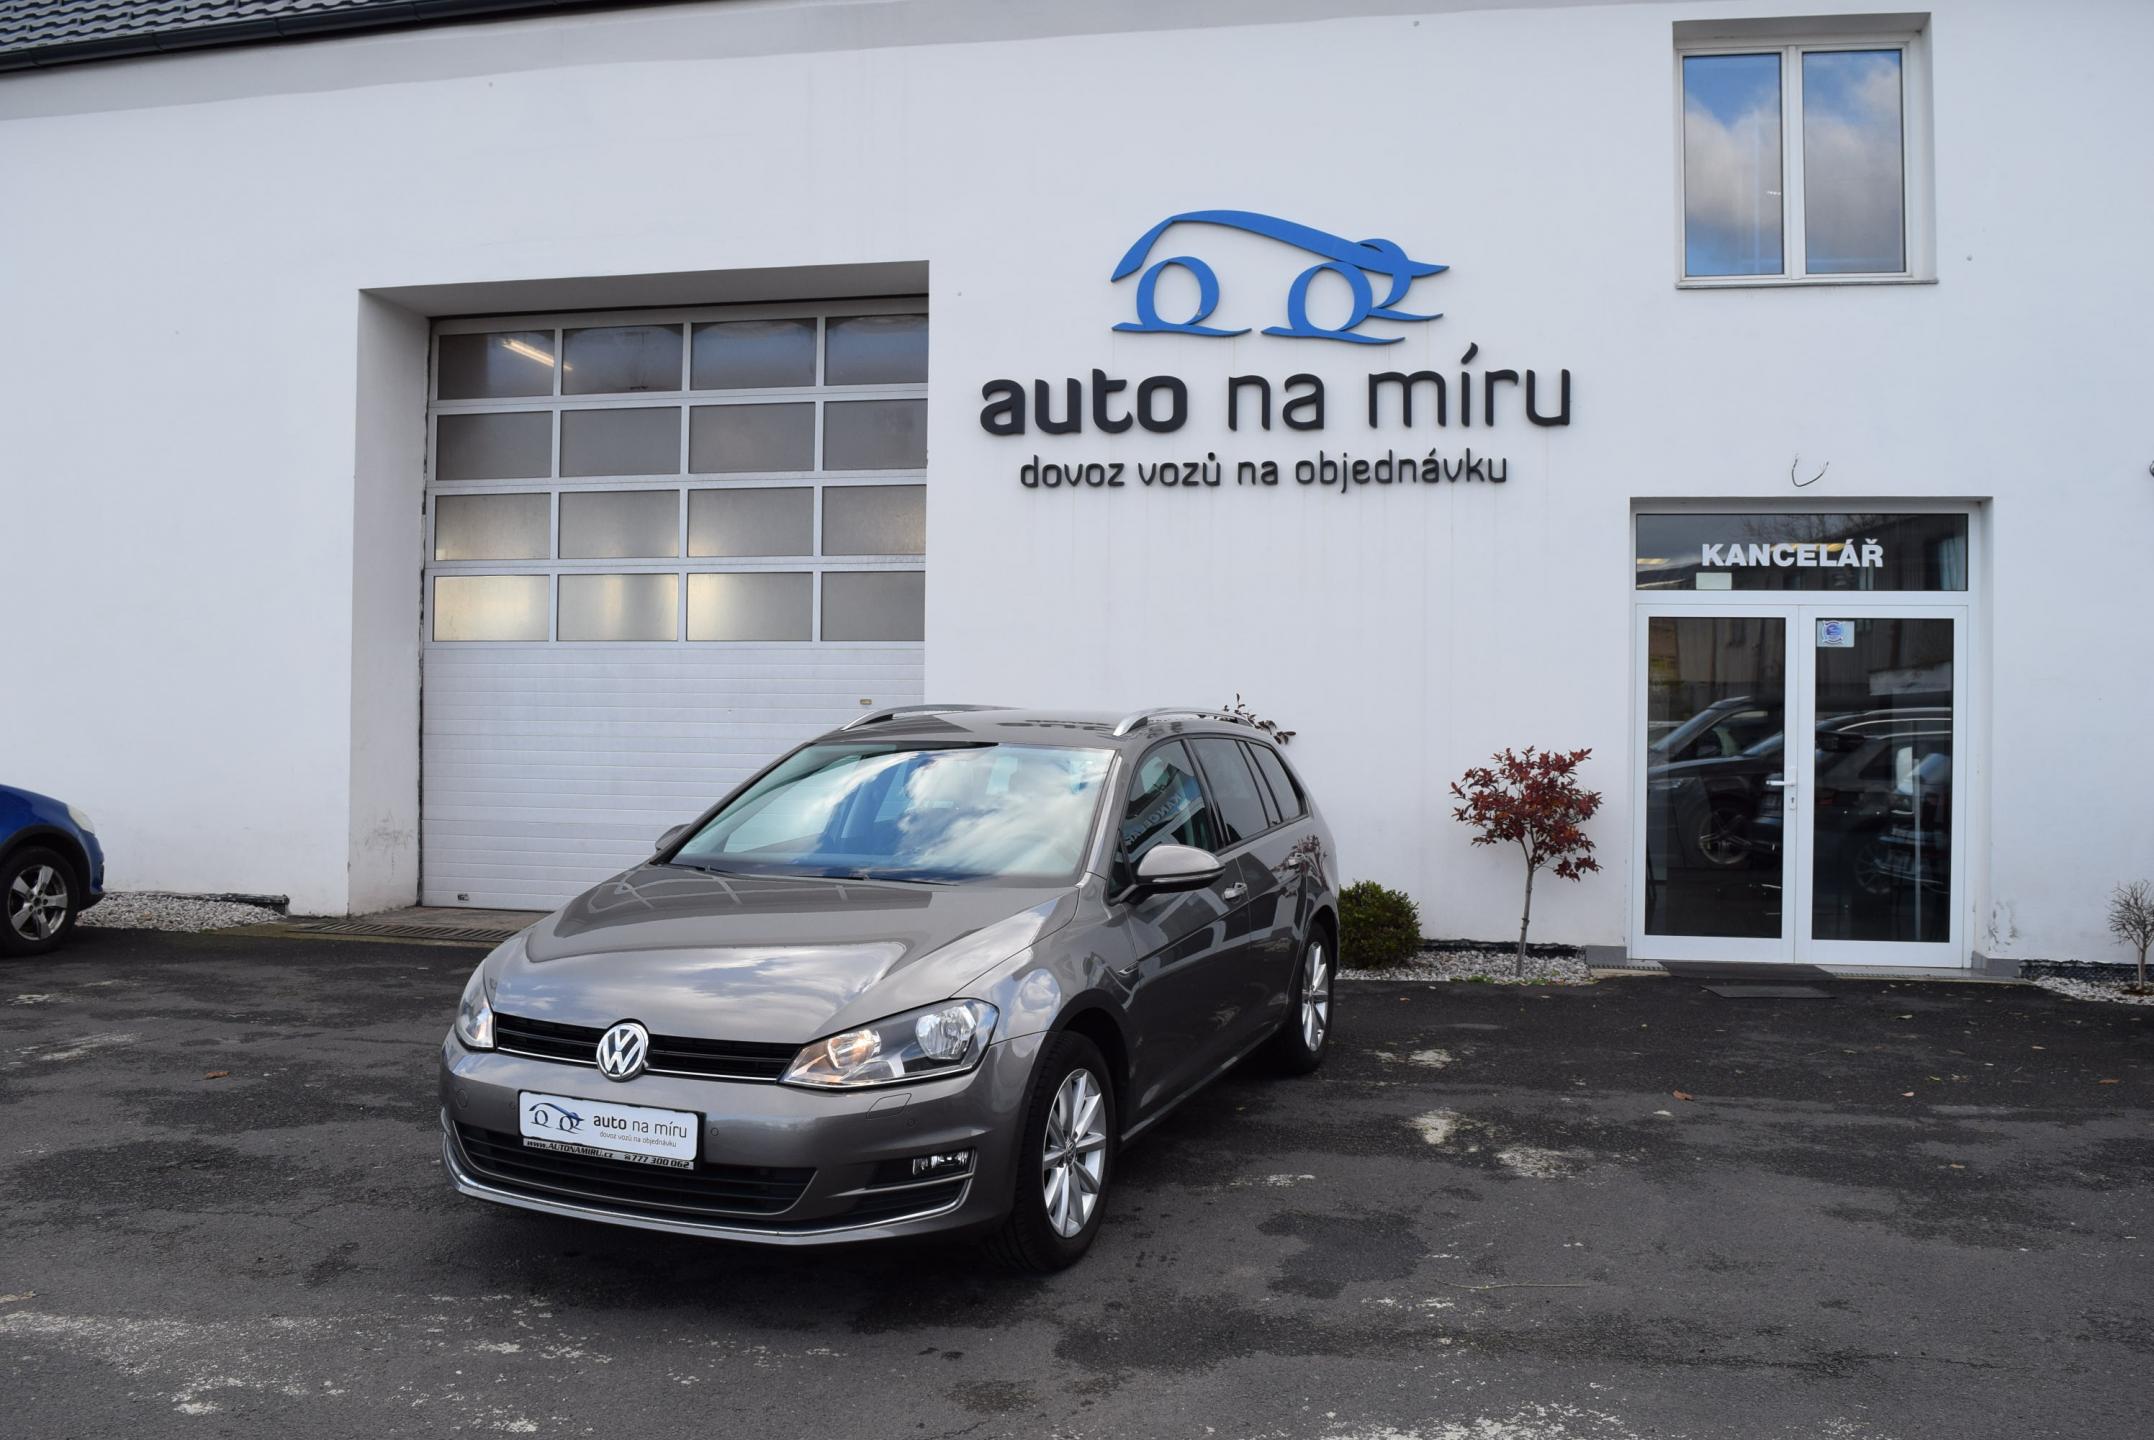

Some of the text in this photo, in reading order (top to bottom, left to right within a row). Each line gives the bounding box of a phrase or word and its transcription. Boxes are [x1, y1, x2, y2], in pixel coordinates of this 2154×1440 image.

[980, 342, 1571, 436] auto na míru
[1020, 448, 1508, 494] dovoz vozů na objednávku
[1702, 538, 1883, 568] KANCELÁŘ
[593, 1115, 688, 1139] auto na míru
[632, 1154, 649, 1163] 777
[651, 1157, 669, 1166] 300
